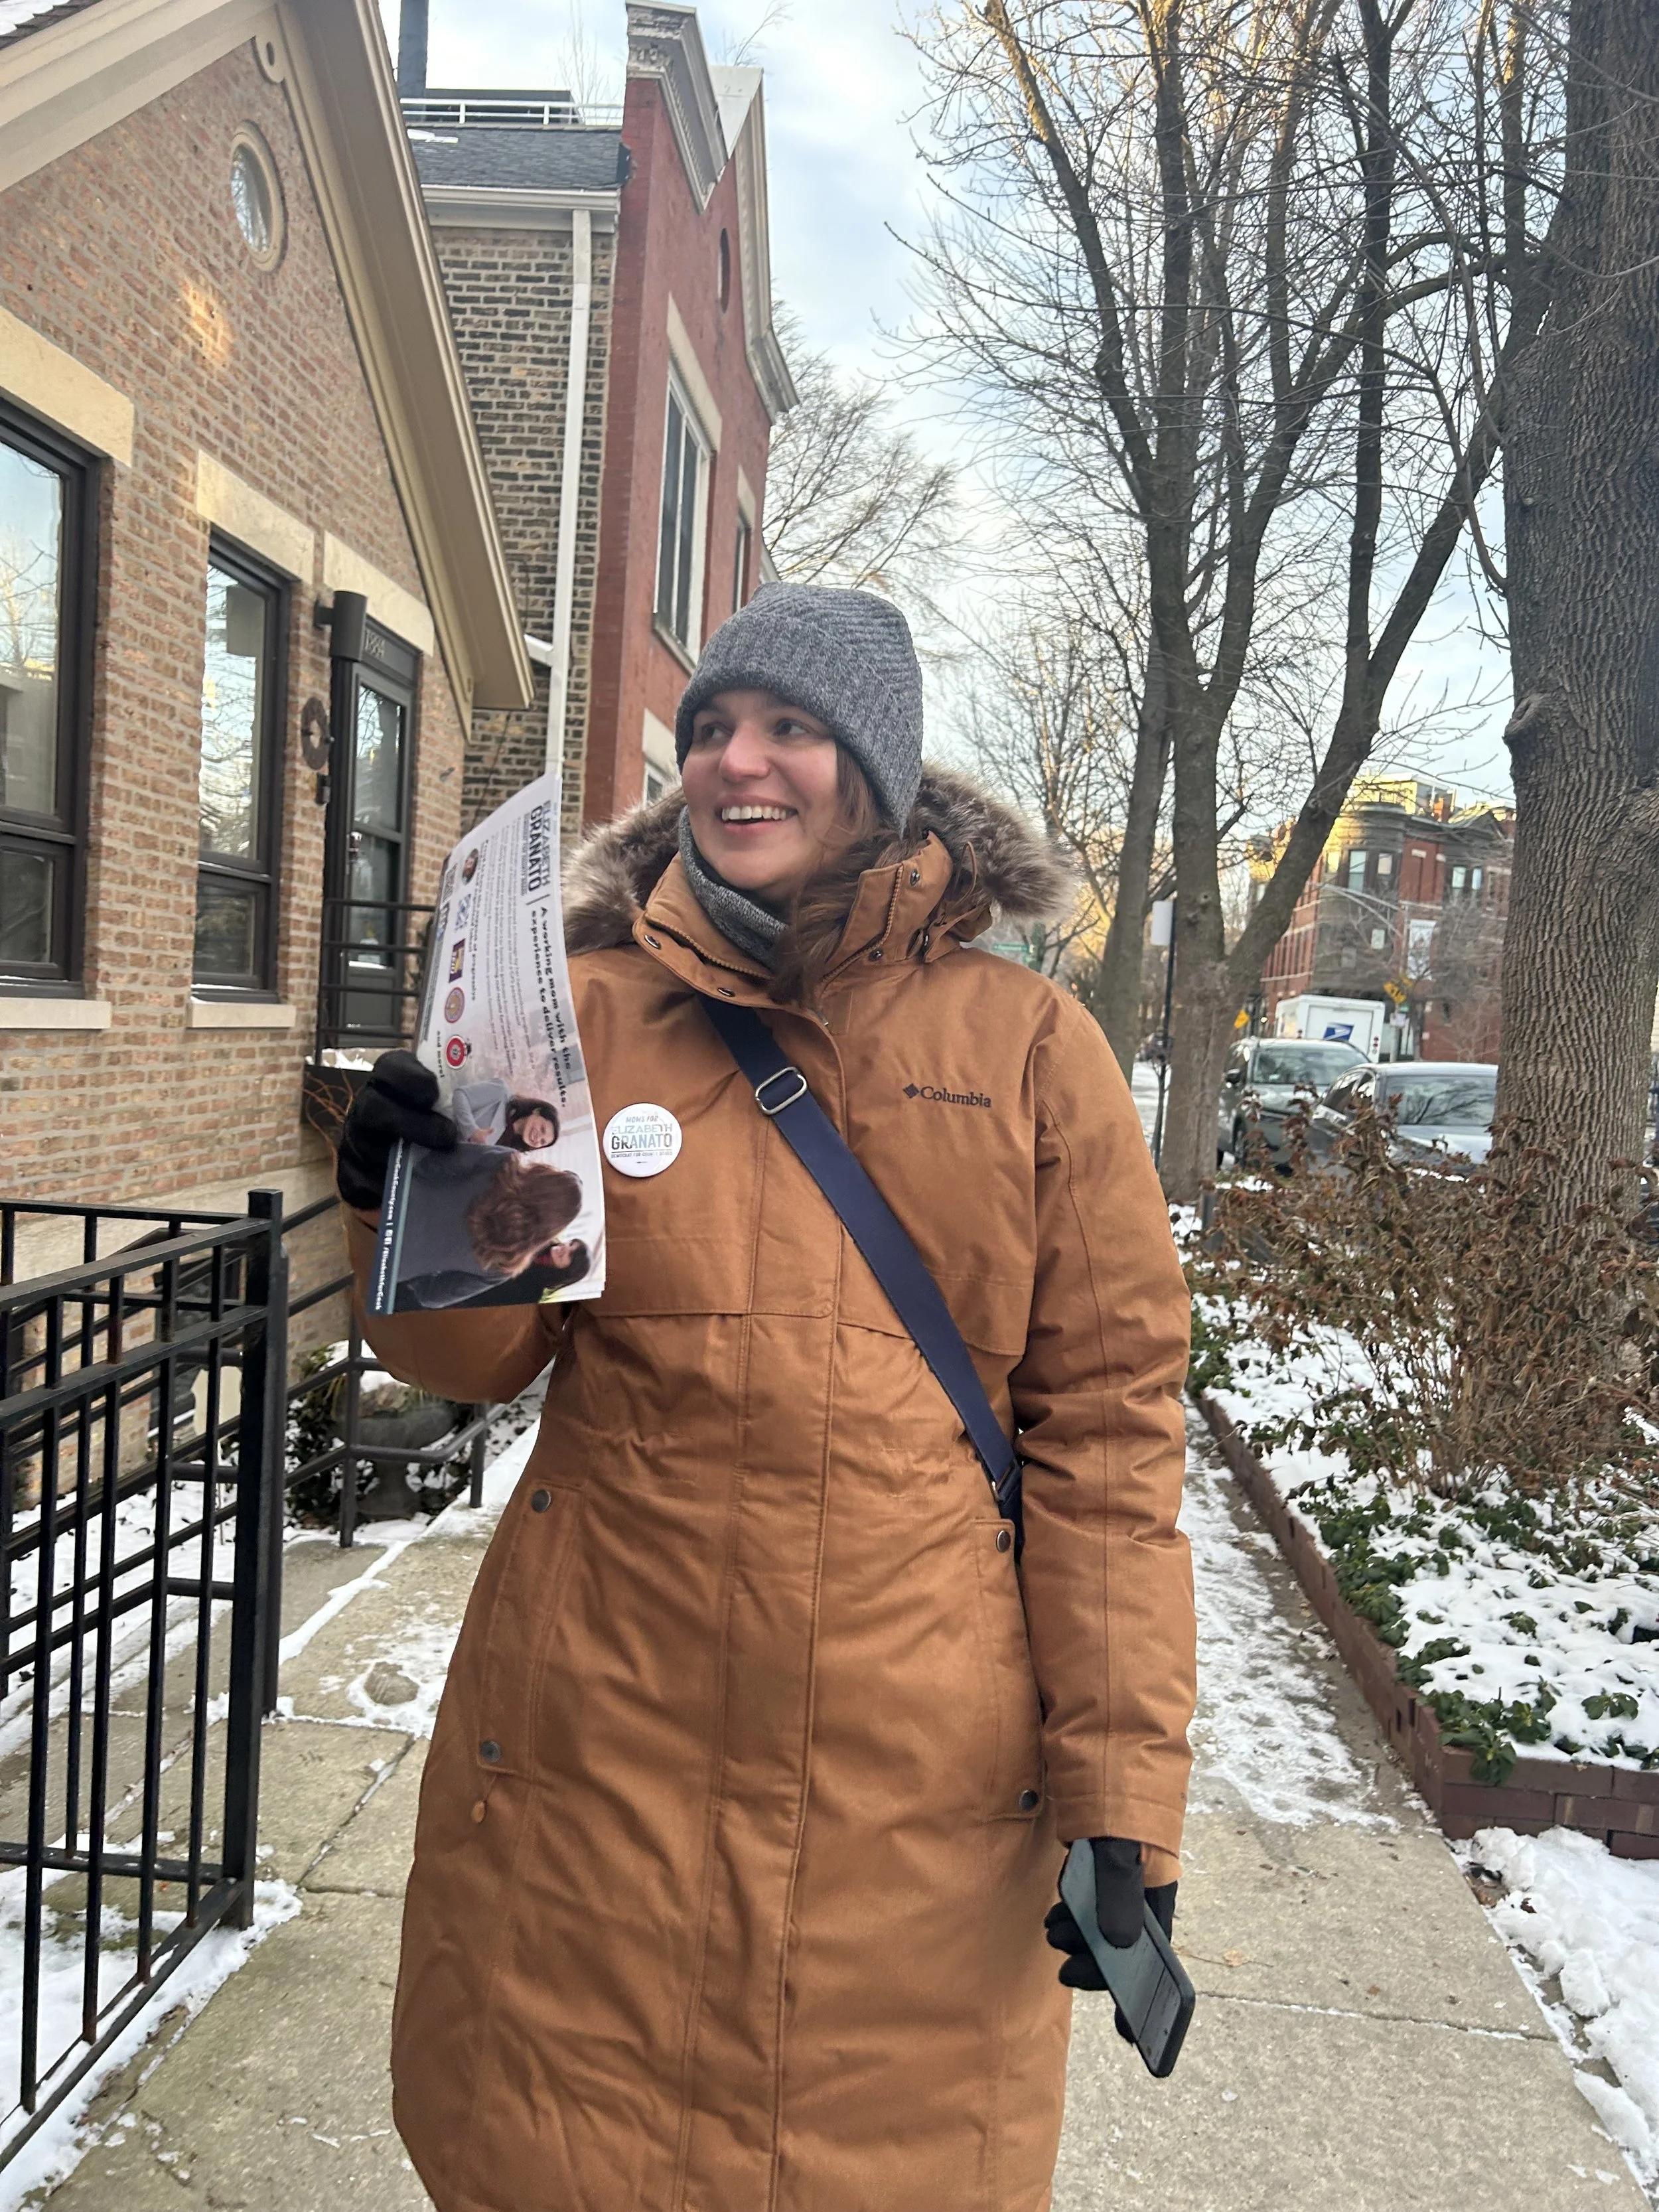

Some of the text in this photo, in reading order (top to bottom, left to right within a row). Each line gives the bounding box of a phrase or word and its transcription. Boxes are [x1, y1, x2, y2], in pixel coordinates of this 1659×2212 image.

[528, 805, 543, 892] GRANATO
[531, 910, 567, 1108] experience to deliver results.
[541, 907, 572, 1070] A working mom with the
[920, 1085, 992, 1108] Columbia
[611, 1124, 673, 1135] ELIZABETH
[611, 1134, 673, 1150] GRANATO
